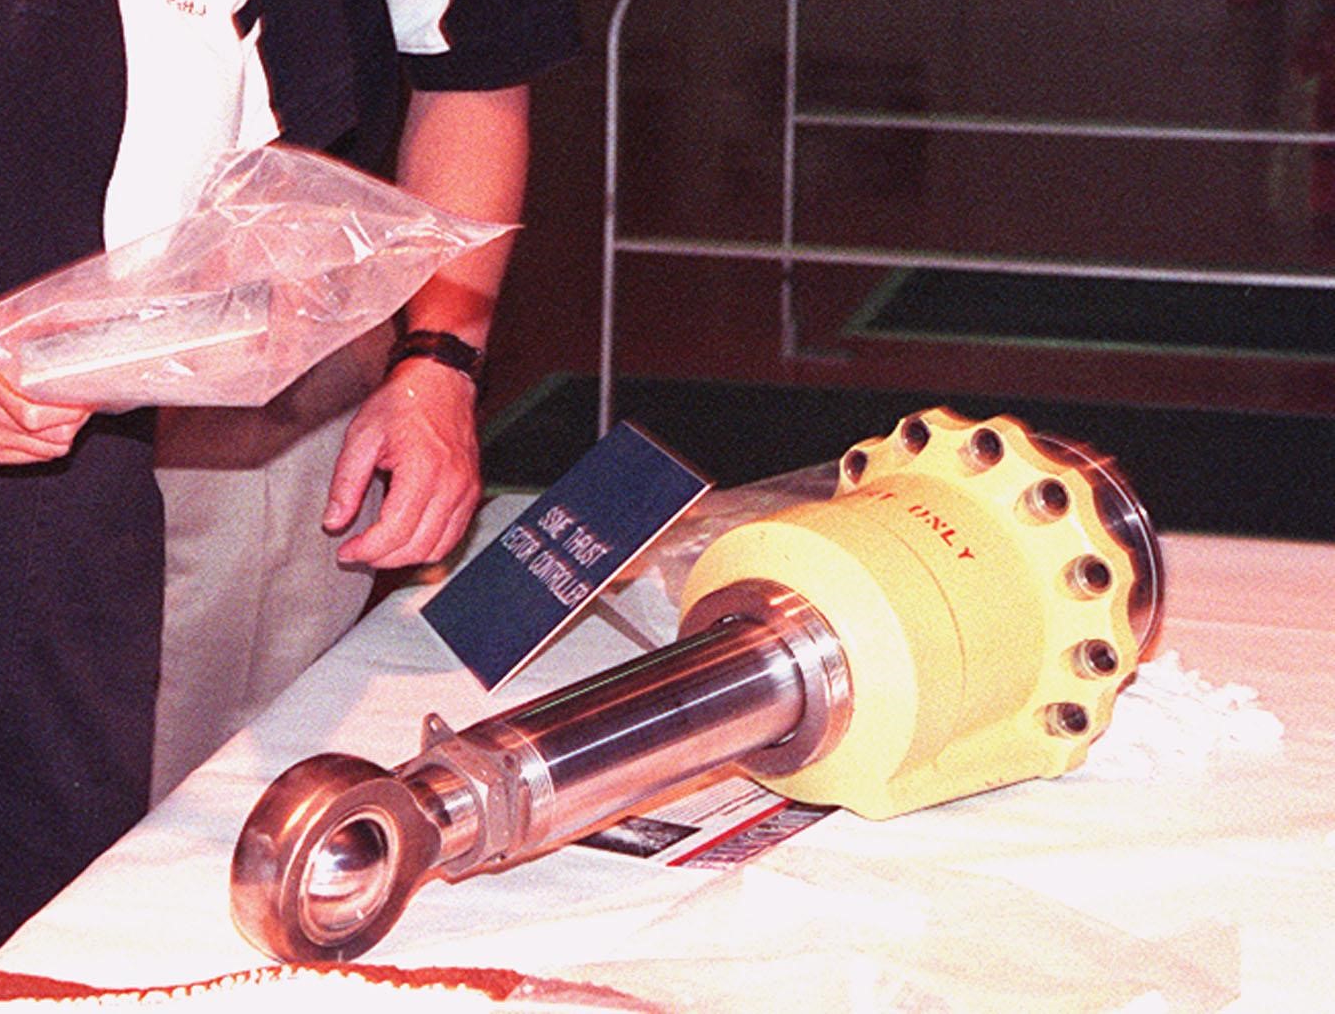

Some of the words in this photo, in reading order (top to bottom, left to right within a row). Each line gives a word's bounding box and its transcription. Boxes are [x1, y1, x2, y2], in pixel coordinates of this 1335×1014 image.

[561, 526, 609, 570] THRUST
[908, 504, 976, 560] ONLY
[499, 525, 541, 564] VECTOR
[528, 550, 591, 610] CONTROLLER
